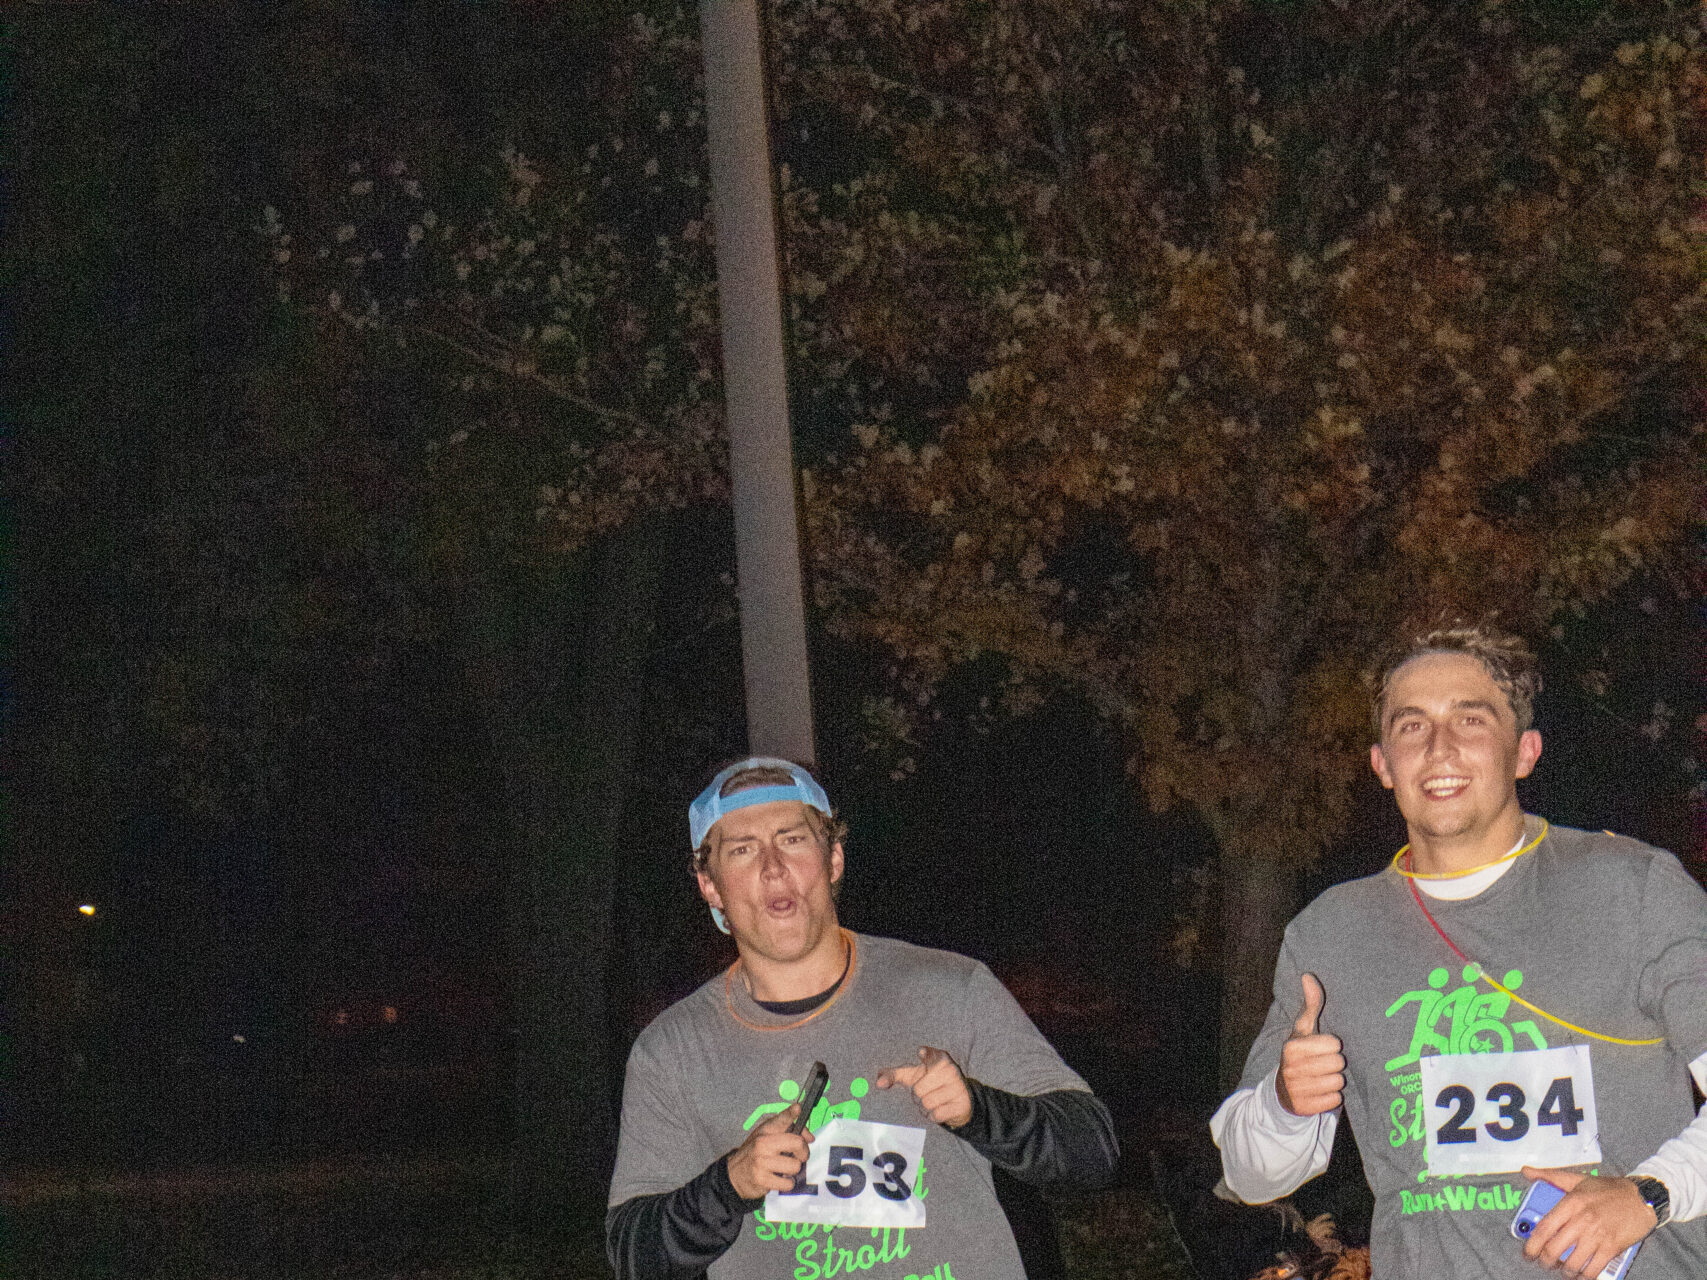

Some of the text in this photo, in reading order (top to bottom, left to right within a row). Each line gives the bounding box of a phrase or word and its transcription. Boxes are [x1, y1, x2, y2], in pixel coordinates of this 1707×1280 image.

[1435, 1076, 1584, 1144] 234
[1399, 1184, 1523, 1215] Run Walk
